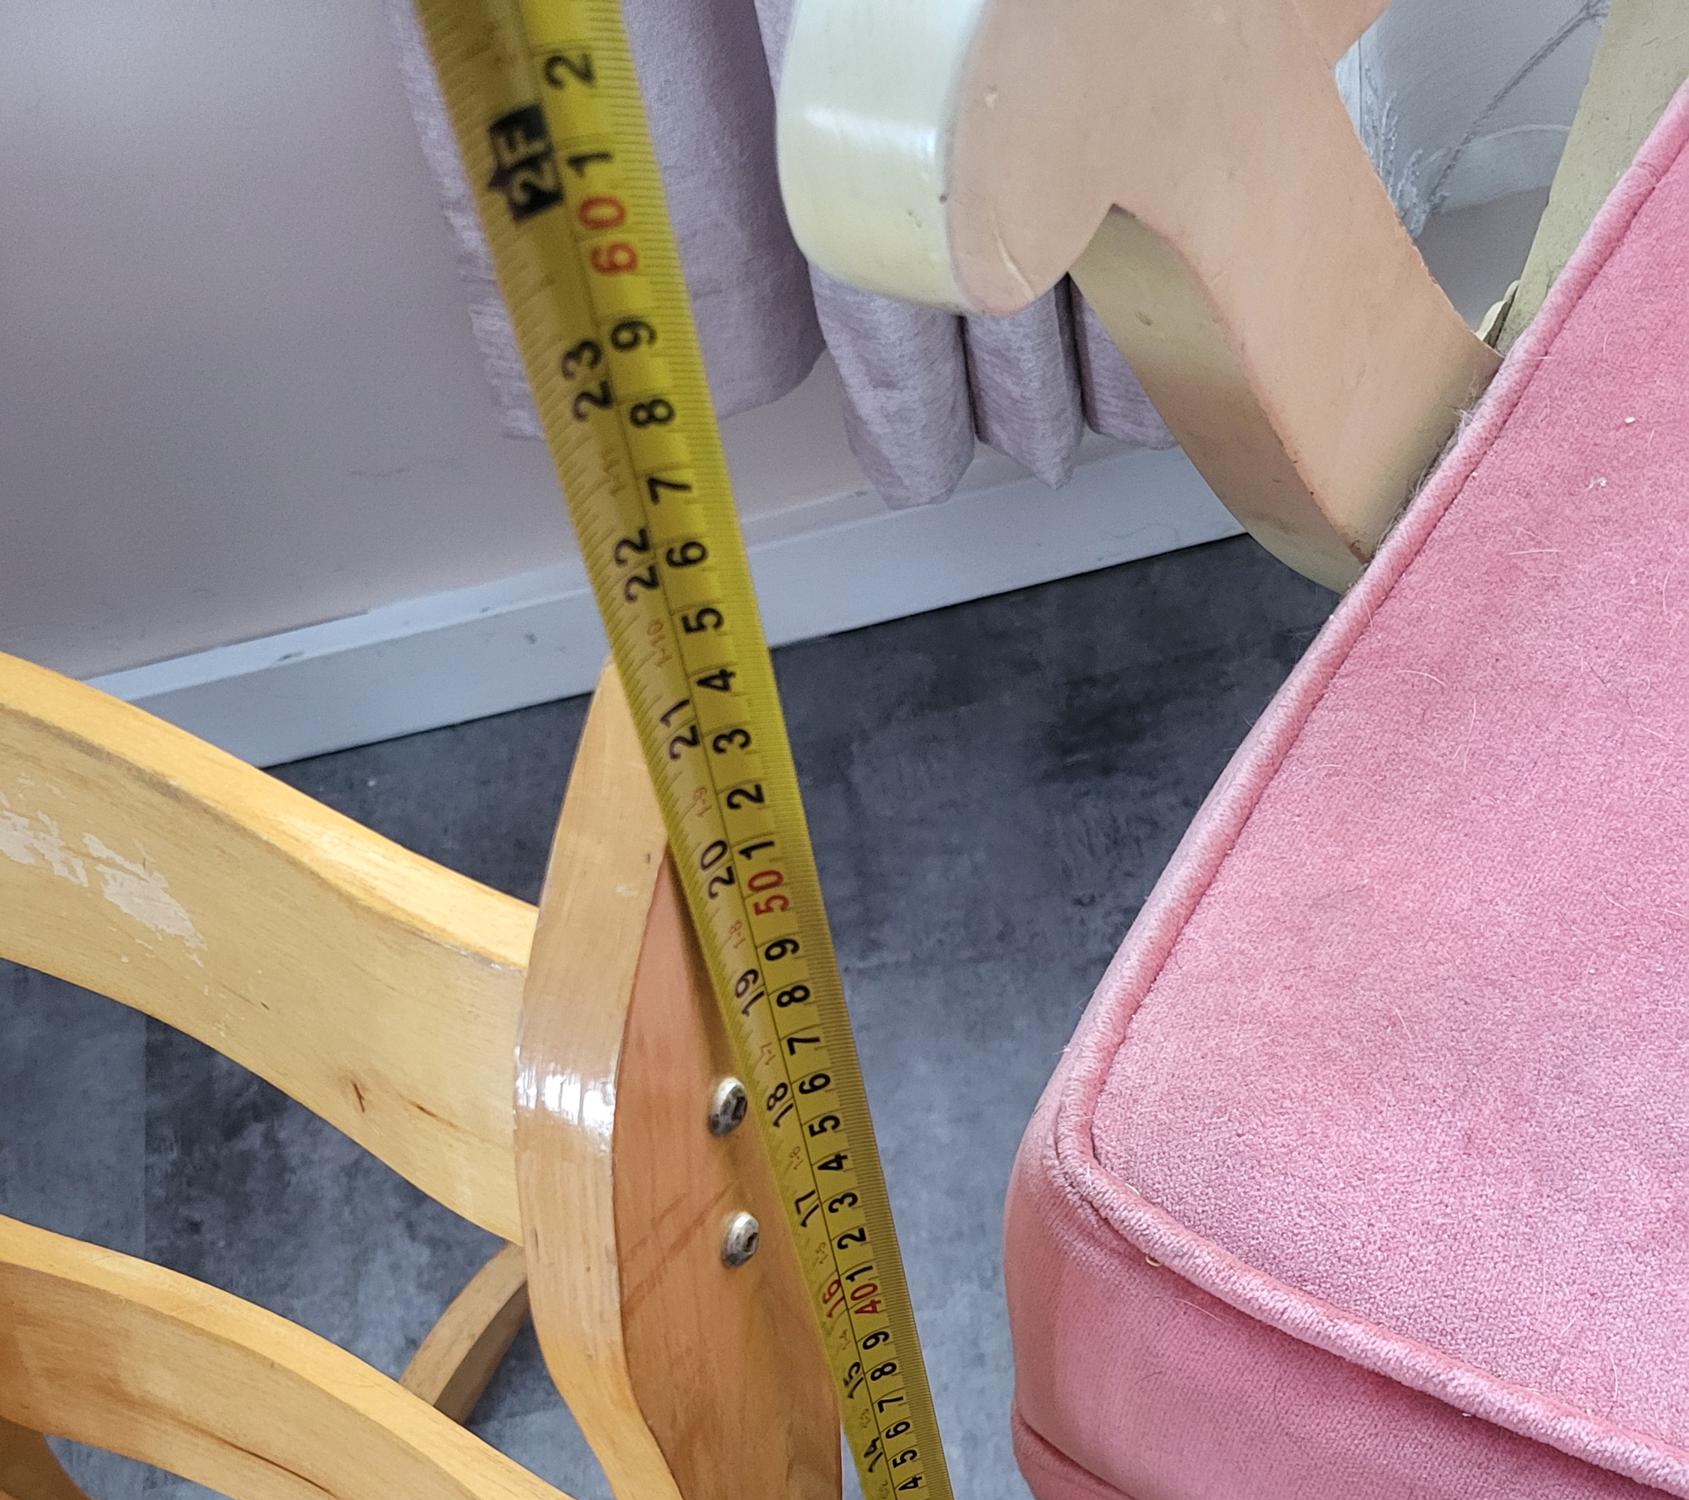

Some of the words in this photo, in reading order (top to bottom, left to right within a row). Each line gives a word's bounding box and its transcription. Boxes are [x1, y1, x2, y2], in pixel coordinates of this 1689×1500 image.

[545, 53, 595, 89] 2
[567, 150, 613, 177] 1
[578, 195, 639, 275] 60
[611, 317, 657, 352] 9
[561, 339, 614, 421] 23
[629, 398, 675, 428] 8
[647, 476, 692, 505] 7
[614, 528, 659, 603] 22
[666, 540, 708, 568] 6
[682, 607, 724, 634] 5
[697, 668, 736, 691] 4
[660, 699, 700, 760] 21
[713, 728, 751, 754] 3
[726, 783, 765, 810] 2
[739, 840, 775, 860] 1
[700, 839, 735, 899] 20
[748, 869, 790, 916] 50
[764, 938, 800, 961] 9
[735, 968, 765, 1016] 19
[776, 984, 811, 1008] 8
[787, 1036, 820, 1056] 7
[799, 1073, 830, 1094] 6
[766, 1082, 794, 1128] 18
[808, 1115, 841, 1137] 5
[818, 1153, 848, 1171] 4
[795, 1189, 820, 1228] 17
[828, 1191, 858, 1213] 3
[837, 1227, 867, 1250] 2
[846, 1265, 873, 1282] 1
[821, 1278, 845, 1318] 16
[851, 1282, 882, 1314] 40
[862, 1330, 890, 1351] 9
[843, 1362, 863, 1399] 15
[870, 1362, 897, 1382] 8
[877, 1396, 904, 1413] 7
[885, 1421, 911, 1440] 6
[863, 1436, 884, 1473] 14
[892, 1449, 918, 1469] 5
[898, 1474, 922, 1491] 4
